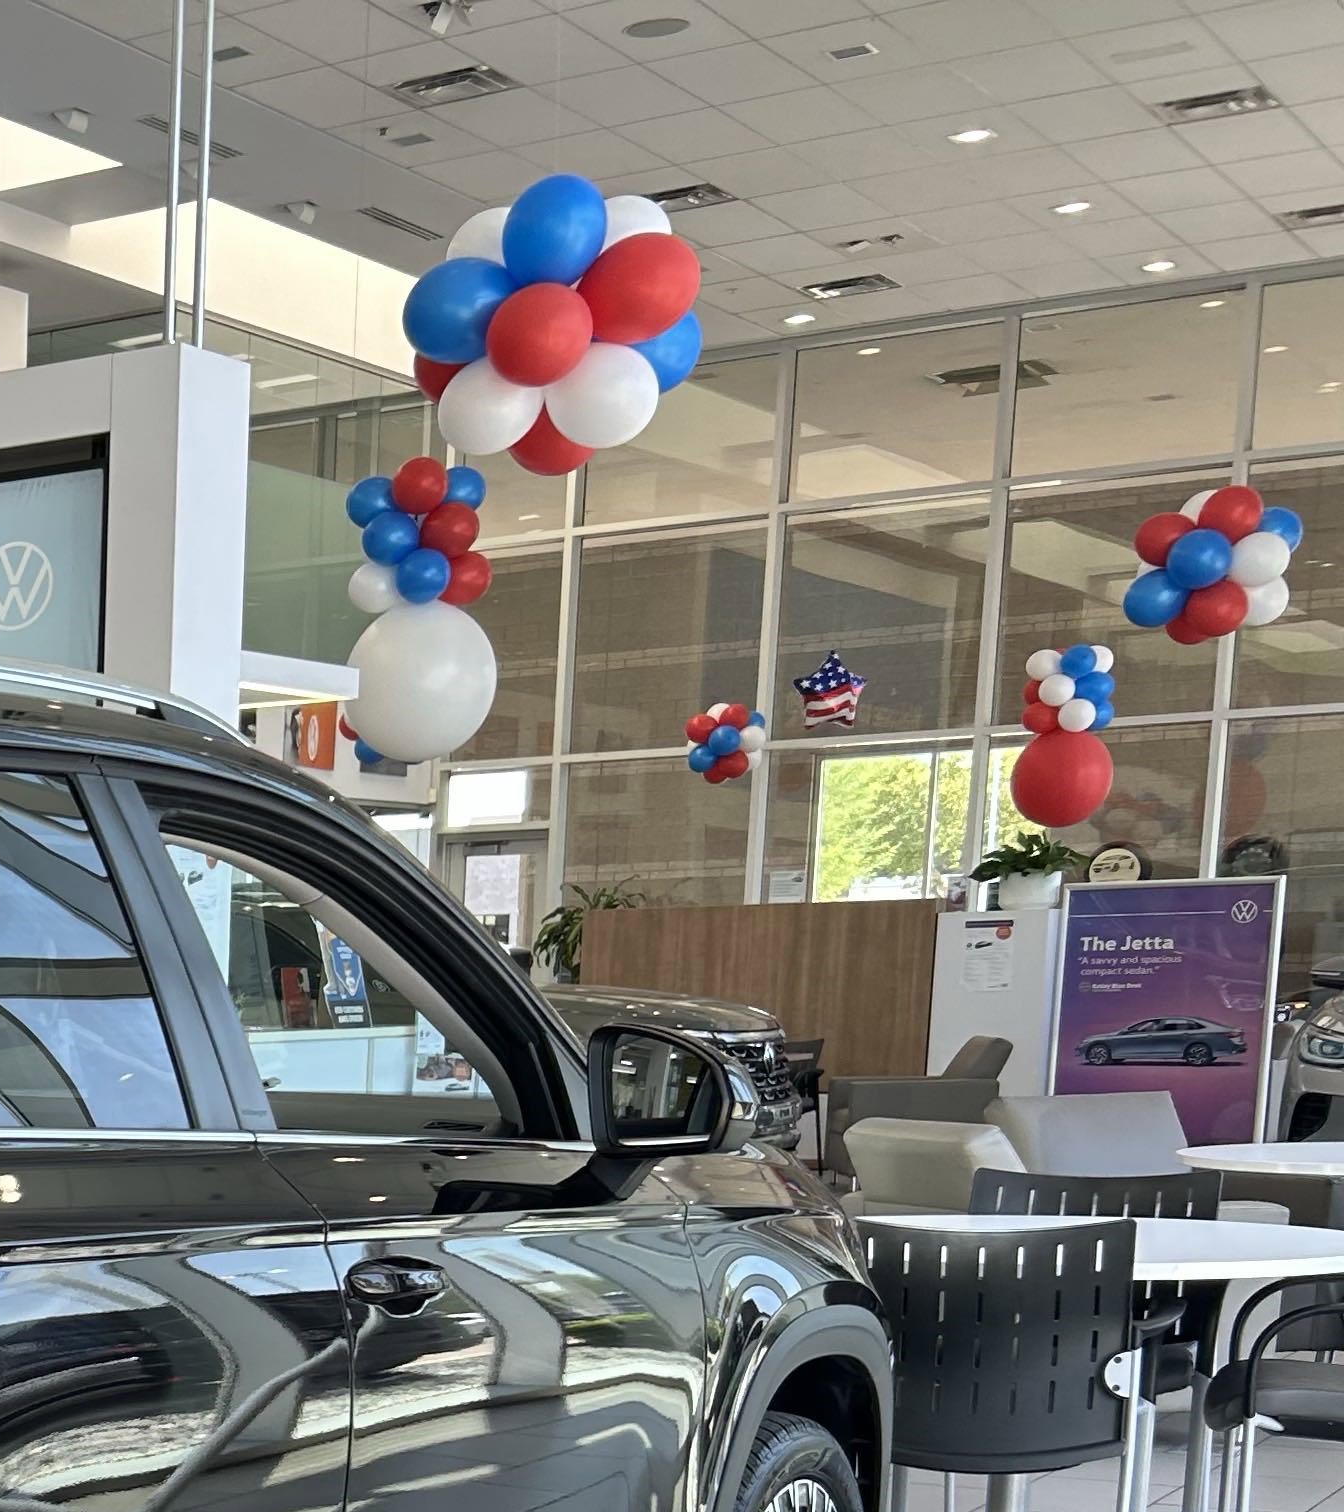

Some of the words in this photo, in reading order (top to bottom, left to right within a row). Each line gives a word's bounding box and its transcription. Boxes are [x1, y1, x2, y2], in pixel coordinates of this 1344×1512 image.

[1080, 936, 1117, 952] The
[1120, 935, 1174, 951] Jetta
[1120, 956, 1138, 964] and
[1141, 956, 1183, 966] spacious
[1080, 967, 1121, 976] compact
